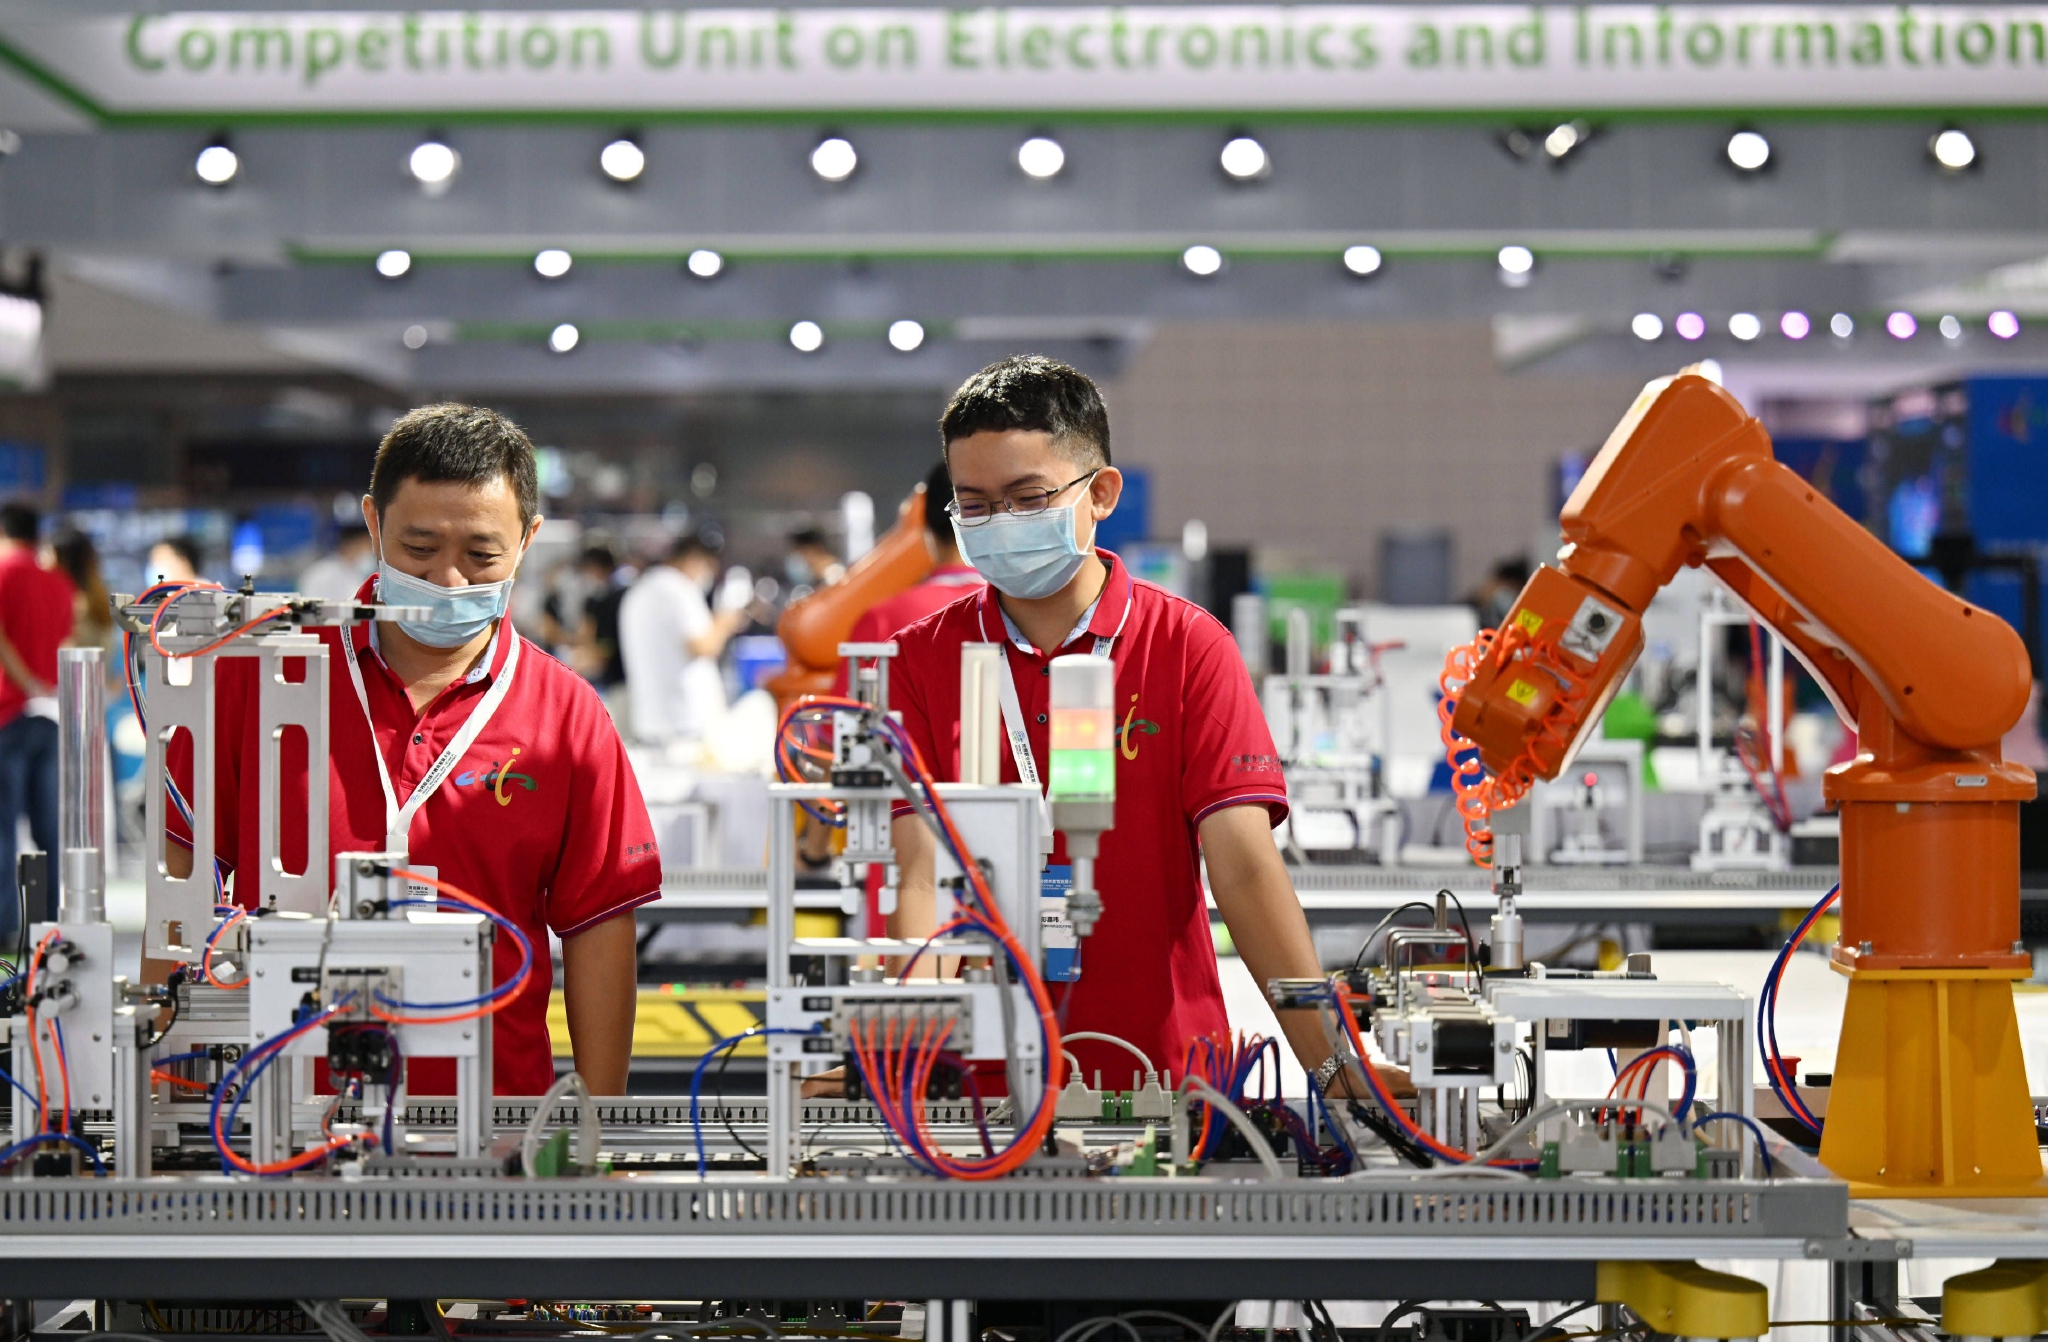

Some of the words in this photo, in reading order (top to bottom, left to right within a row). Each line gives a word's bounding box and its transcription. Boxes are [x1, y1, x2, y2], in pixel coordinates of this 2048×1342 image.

[125, 13, 609, 80] Competition
[640, 13, 795, 68] Unit
[824, 24, 915, 67] on
[945, 10, 1378, 68] Electronics
[1406, 8, 1546, 66] and
[1576, 6, 2047, 65] Information
